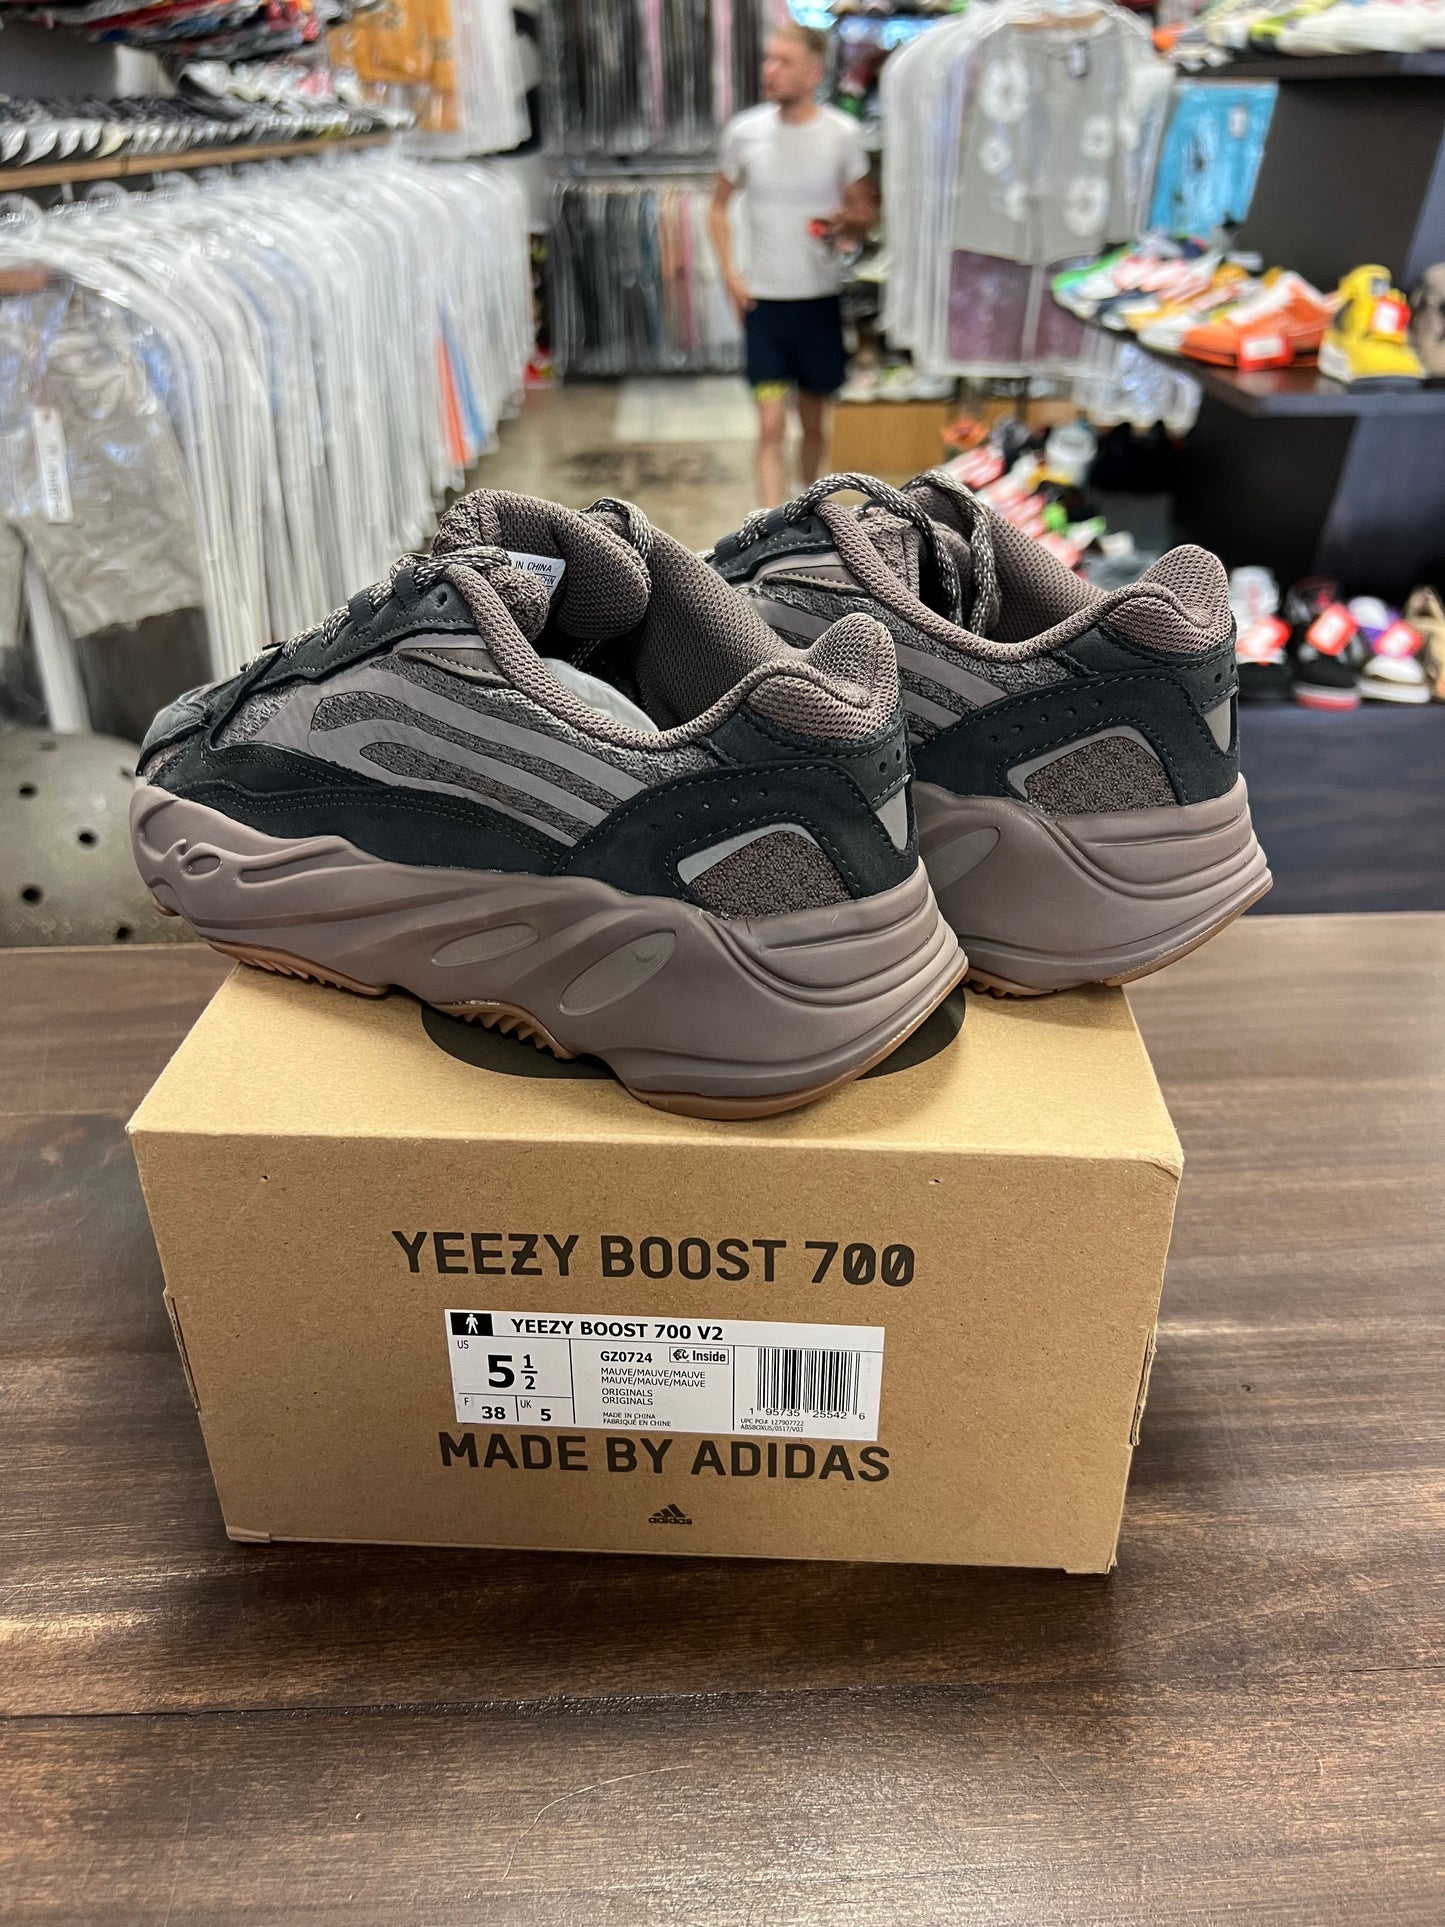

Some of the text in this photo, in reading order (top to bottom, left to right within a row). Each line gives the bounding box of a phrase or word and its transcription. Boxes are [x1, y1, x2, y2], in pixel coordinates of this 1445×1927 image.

[515, 561, 552, 572] IN CHINA
[392, 1231, 916, 1288] YEEZY BOOST 700
[511, 1319, 723, 1341] YEEZY BOOST 700 V2
[457, 1340, 469, 1349] US
[600, 1351, 653, 1363] GZ0724
[692, 1350, 726, 1362] Inside
[601, 1368, 706, 1379] MAUVE/MAUVE/MAUVE
[601, 1376, 706, 1388] MAUVE/MAUVE/MAUVE
[601, 1388, 653, 1398] ORIGINALS
[464, 1397, 469, 1406] F
[520, 1400, 532, 1408] UK
[602, 1396, 654, 1406] ORIGINALS
[482, 1406, 506, 1420] 38
[541, 1409, 551, 1421] 5
[438, 1432, 890, 1482] MADE BY ADIDAS
[648, 1516, 693, 1525] adidas
